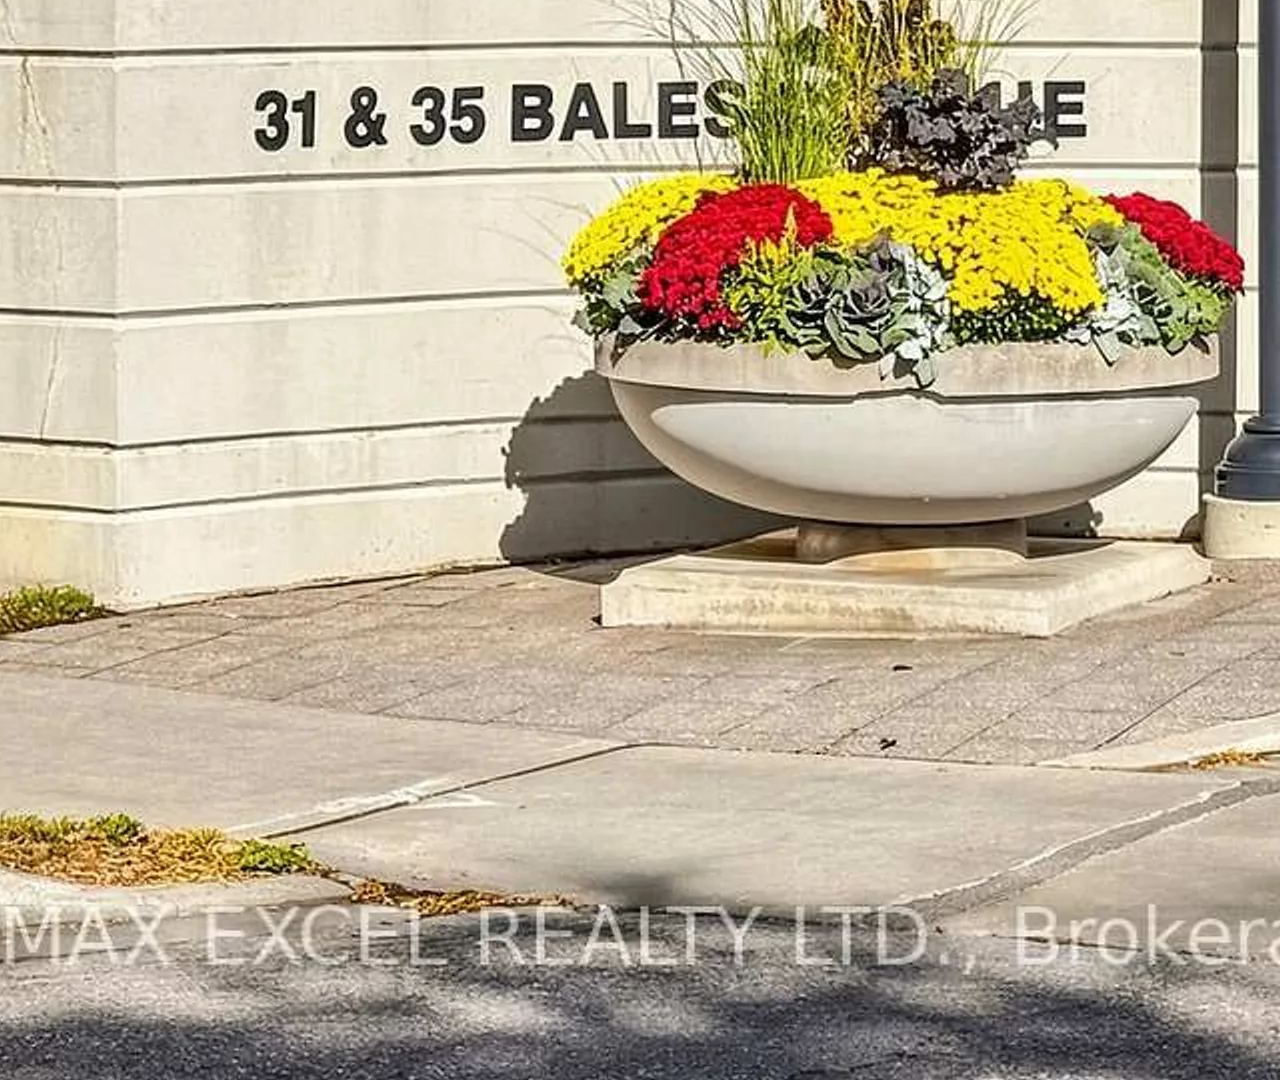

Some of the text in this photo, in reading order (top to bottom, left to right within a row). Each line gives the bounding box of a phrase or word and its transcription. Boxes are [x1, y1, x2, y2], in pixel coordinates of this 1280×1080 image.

[253, 80, 748, 152] 31 & 35 BALES
